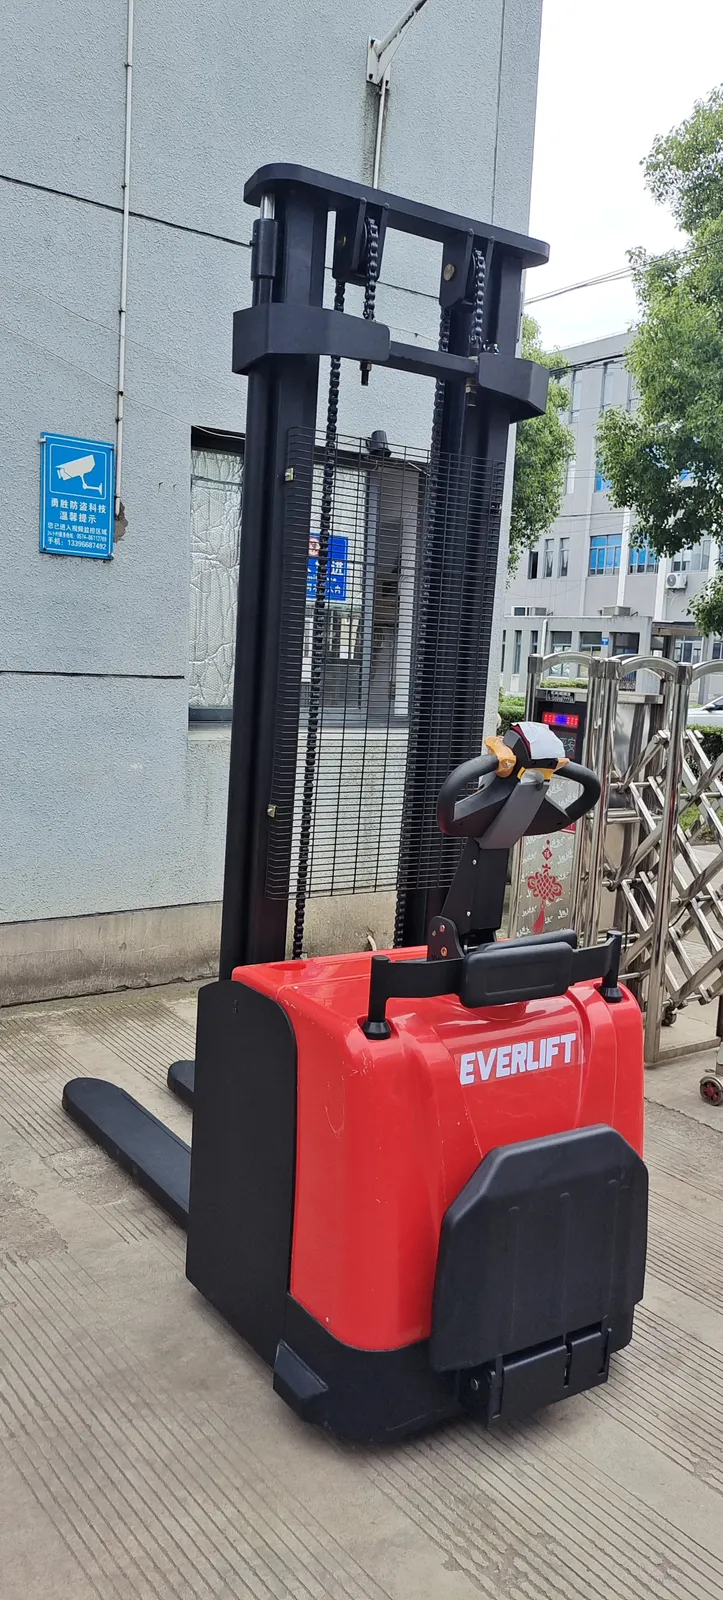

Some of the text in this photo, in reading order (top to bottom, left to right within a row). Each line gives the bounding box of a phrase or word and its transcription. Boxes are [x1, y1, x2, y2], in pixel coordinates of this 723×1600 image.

[51, 497, 107, 514] 勇胜防盗科技
[59, 510, 97, 524] 温馨提示
[47, 522, 107, 536] 您已进入视频监控区域
[460, 1033, 577, 1086] EVERLIFT
